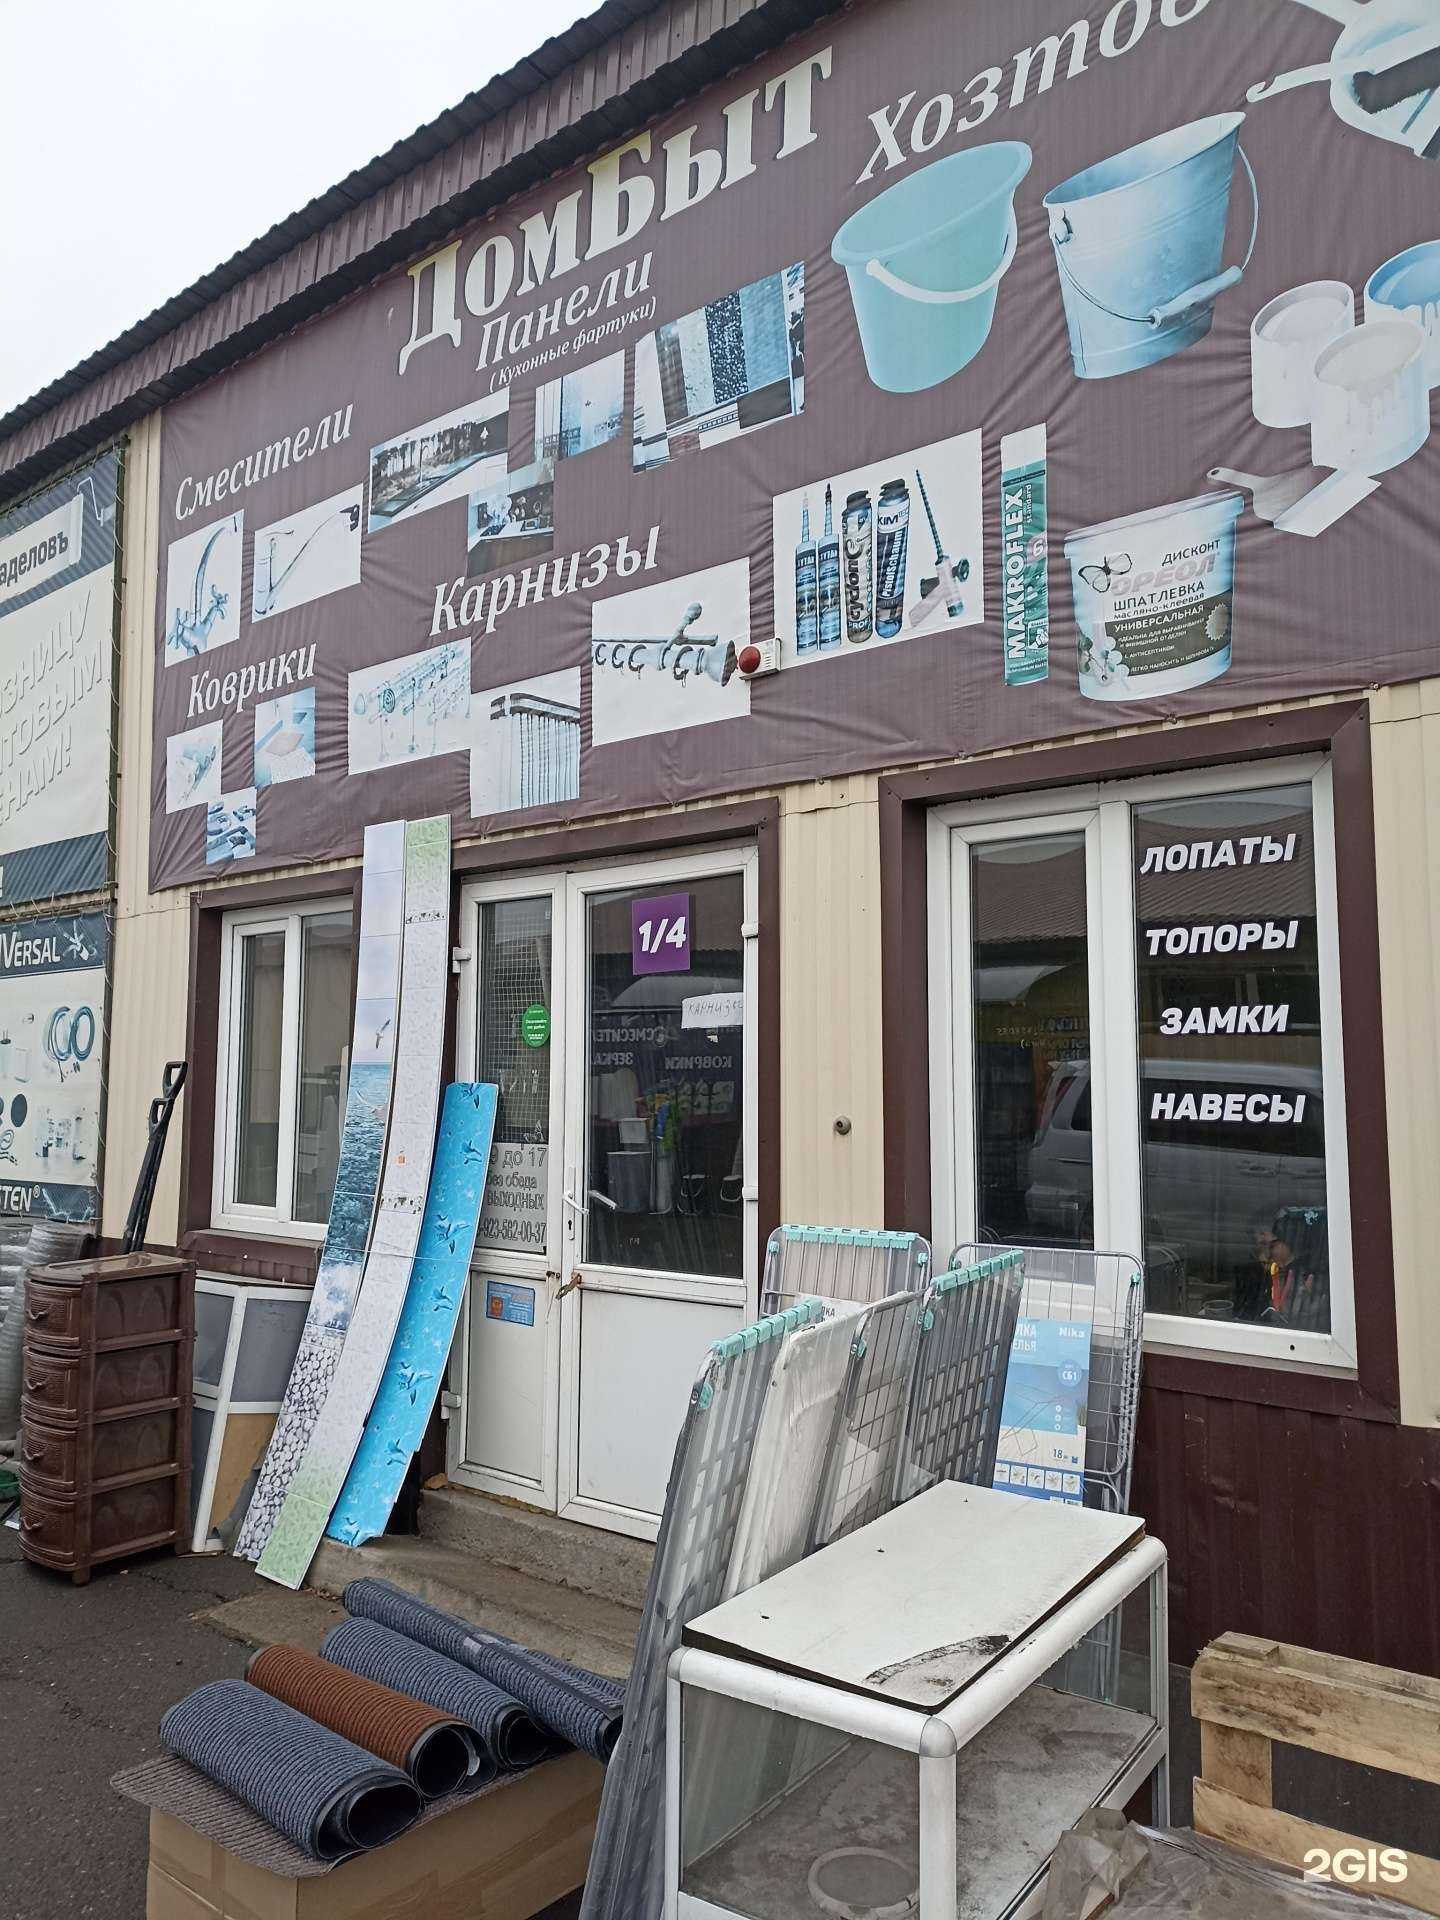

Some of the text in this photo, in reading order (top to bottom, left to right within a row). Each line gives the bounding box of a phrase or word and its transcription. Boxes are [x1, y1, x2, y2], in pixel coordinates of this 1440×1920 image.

[475, 251, 653, 372] Панели
[572, 295, 657, 354] фартуки)
[174, 403, 355, 522] Смесители
[1162, 539, 1220, 567] ДИСКОНТ
[429, 525, 660, 637] Карнизы
[1005, 487, 1026, 660] MAKROFLEX
[1110, 552, 1218, 597] ОРЕОЛ
[1113, 580, 1205, 612] ШПАТЛЕВКА
[1114, 604, 1205, 633] УНИВЕРСАЛЬНАЯ
[0, 588, 92, 718] ЗНИЦУ
[186, 642, 317, 719] Коврики
[1139, 833, 1296, 875] ЛОПАТЫ
[637, 916, 687, 954] 1/4
[1146, 920, 1299, 957] ТОПОРЫ
[1160, 1004, 1290, 1036] ЗАМКИ
[1149, 1092, 1307, 1123] НАВЕСЫ
[528, 1147, 547, 1167] 17
[505, 1171, 538, 1190] обеда
[1059, 1327, 1085, 1338] Nika
